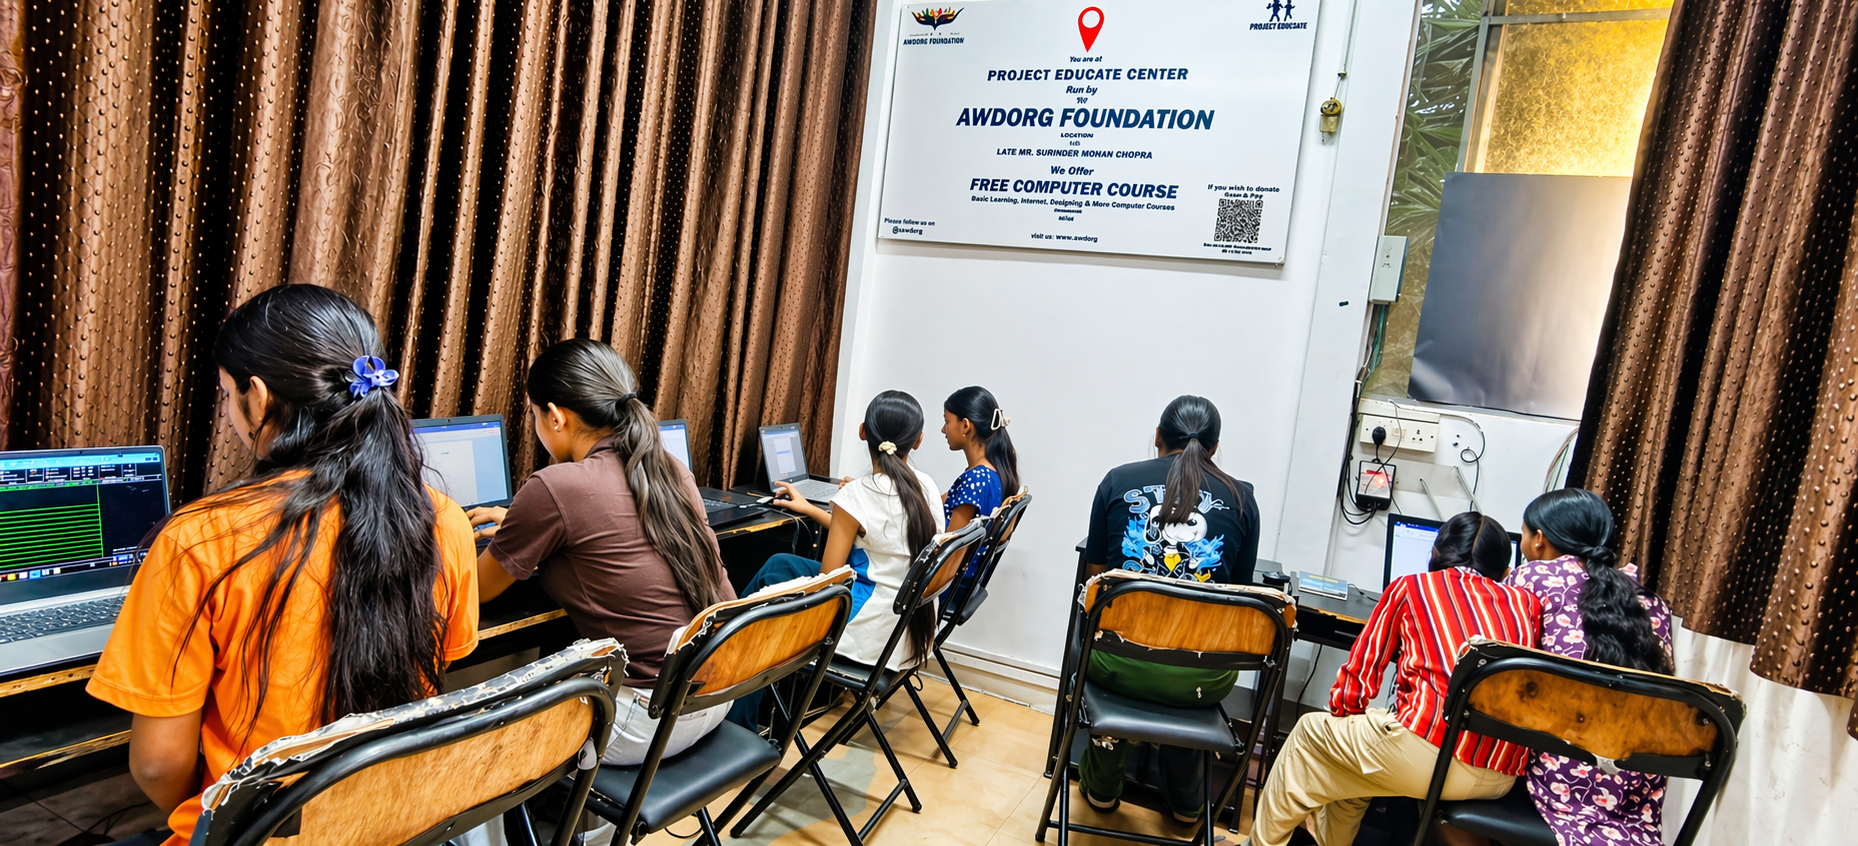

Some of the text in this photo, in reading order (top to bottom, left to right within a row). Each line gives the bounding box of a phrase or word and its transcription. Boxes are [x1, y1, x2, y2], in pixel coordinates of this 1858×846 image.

[1069, 55, 1082, 63] You
[987, 68, 1189, 81] PROJECT EDUCATE CENTER
[1066, 85, 1098, 96] Run by
[956, 108, 1215, 130] AWDORG FOUNDATION
[997, 148, 1153, 159] LATE MR. SURINDER MOHAN CHOPRA
[1050, 165, 1095, 176] We Offer
[970, 178, 1179, 199] FREE COMPUTER COURSE
[990, 196, 1020, 205] Learning,
[1111, 201, 1145, 210] Computer
[1146, 203, 1175, 211] Courses
